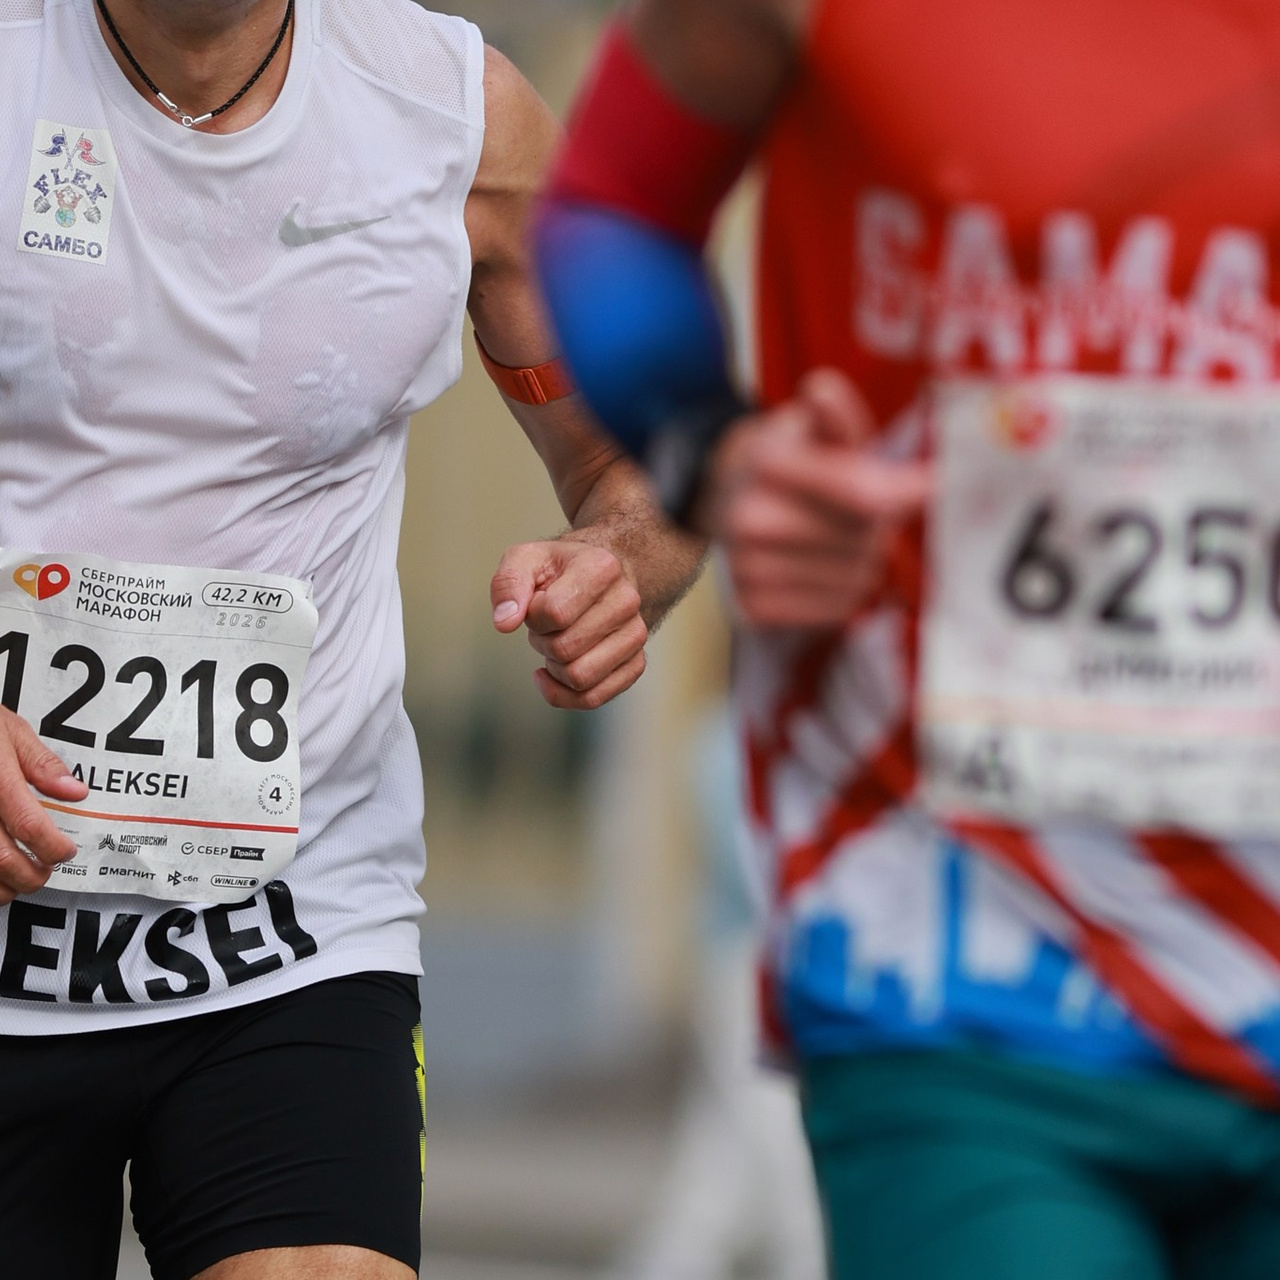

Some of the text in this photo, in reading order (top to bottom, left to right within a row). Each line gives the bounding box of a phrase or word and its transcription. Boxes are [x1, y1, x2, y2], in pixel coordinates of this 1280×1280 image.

[33, 168, 107, 204] FLEX
[23, 230, 103, 259] САМБО
[1000, 496, 1280, 633] 625
[81, 567, 165, 590] СБЕРПРАЙМ
[78, 580, 193, 608] МОСКОВСКИЙ
[211, 587, 247, 604] 42,2
[76, 596, 161, 622] МАРАФОН
[216, 612, 267, 629] 2026
[70, 763, 188, 799] ALEKSEI
[268, 786, 282, 802] 4
[120, 834, 168, 846] МОСКОВСКИЙ
[117, 844, 141, 855] СПОРТ
[197, 845, 259, 858] СБЕР Прайм
[61, 866, 87, 877] BRICS
[109, 867, 157, 881] магнит
[182, 874, 199, 883] сбп
[214, 876, 249, 887] WINLINE
